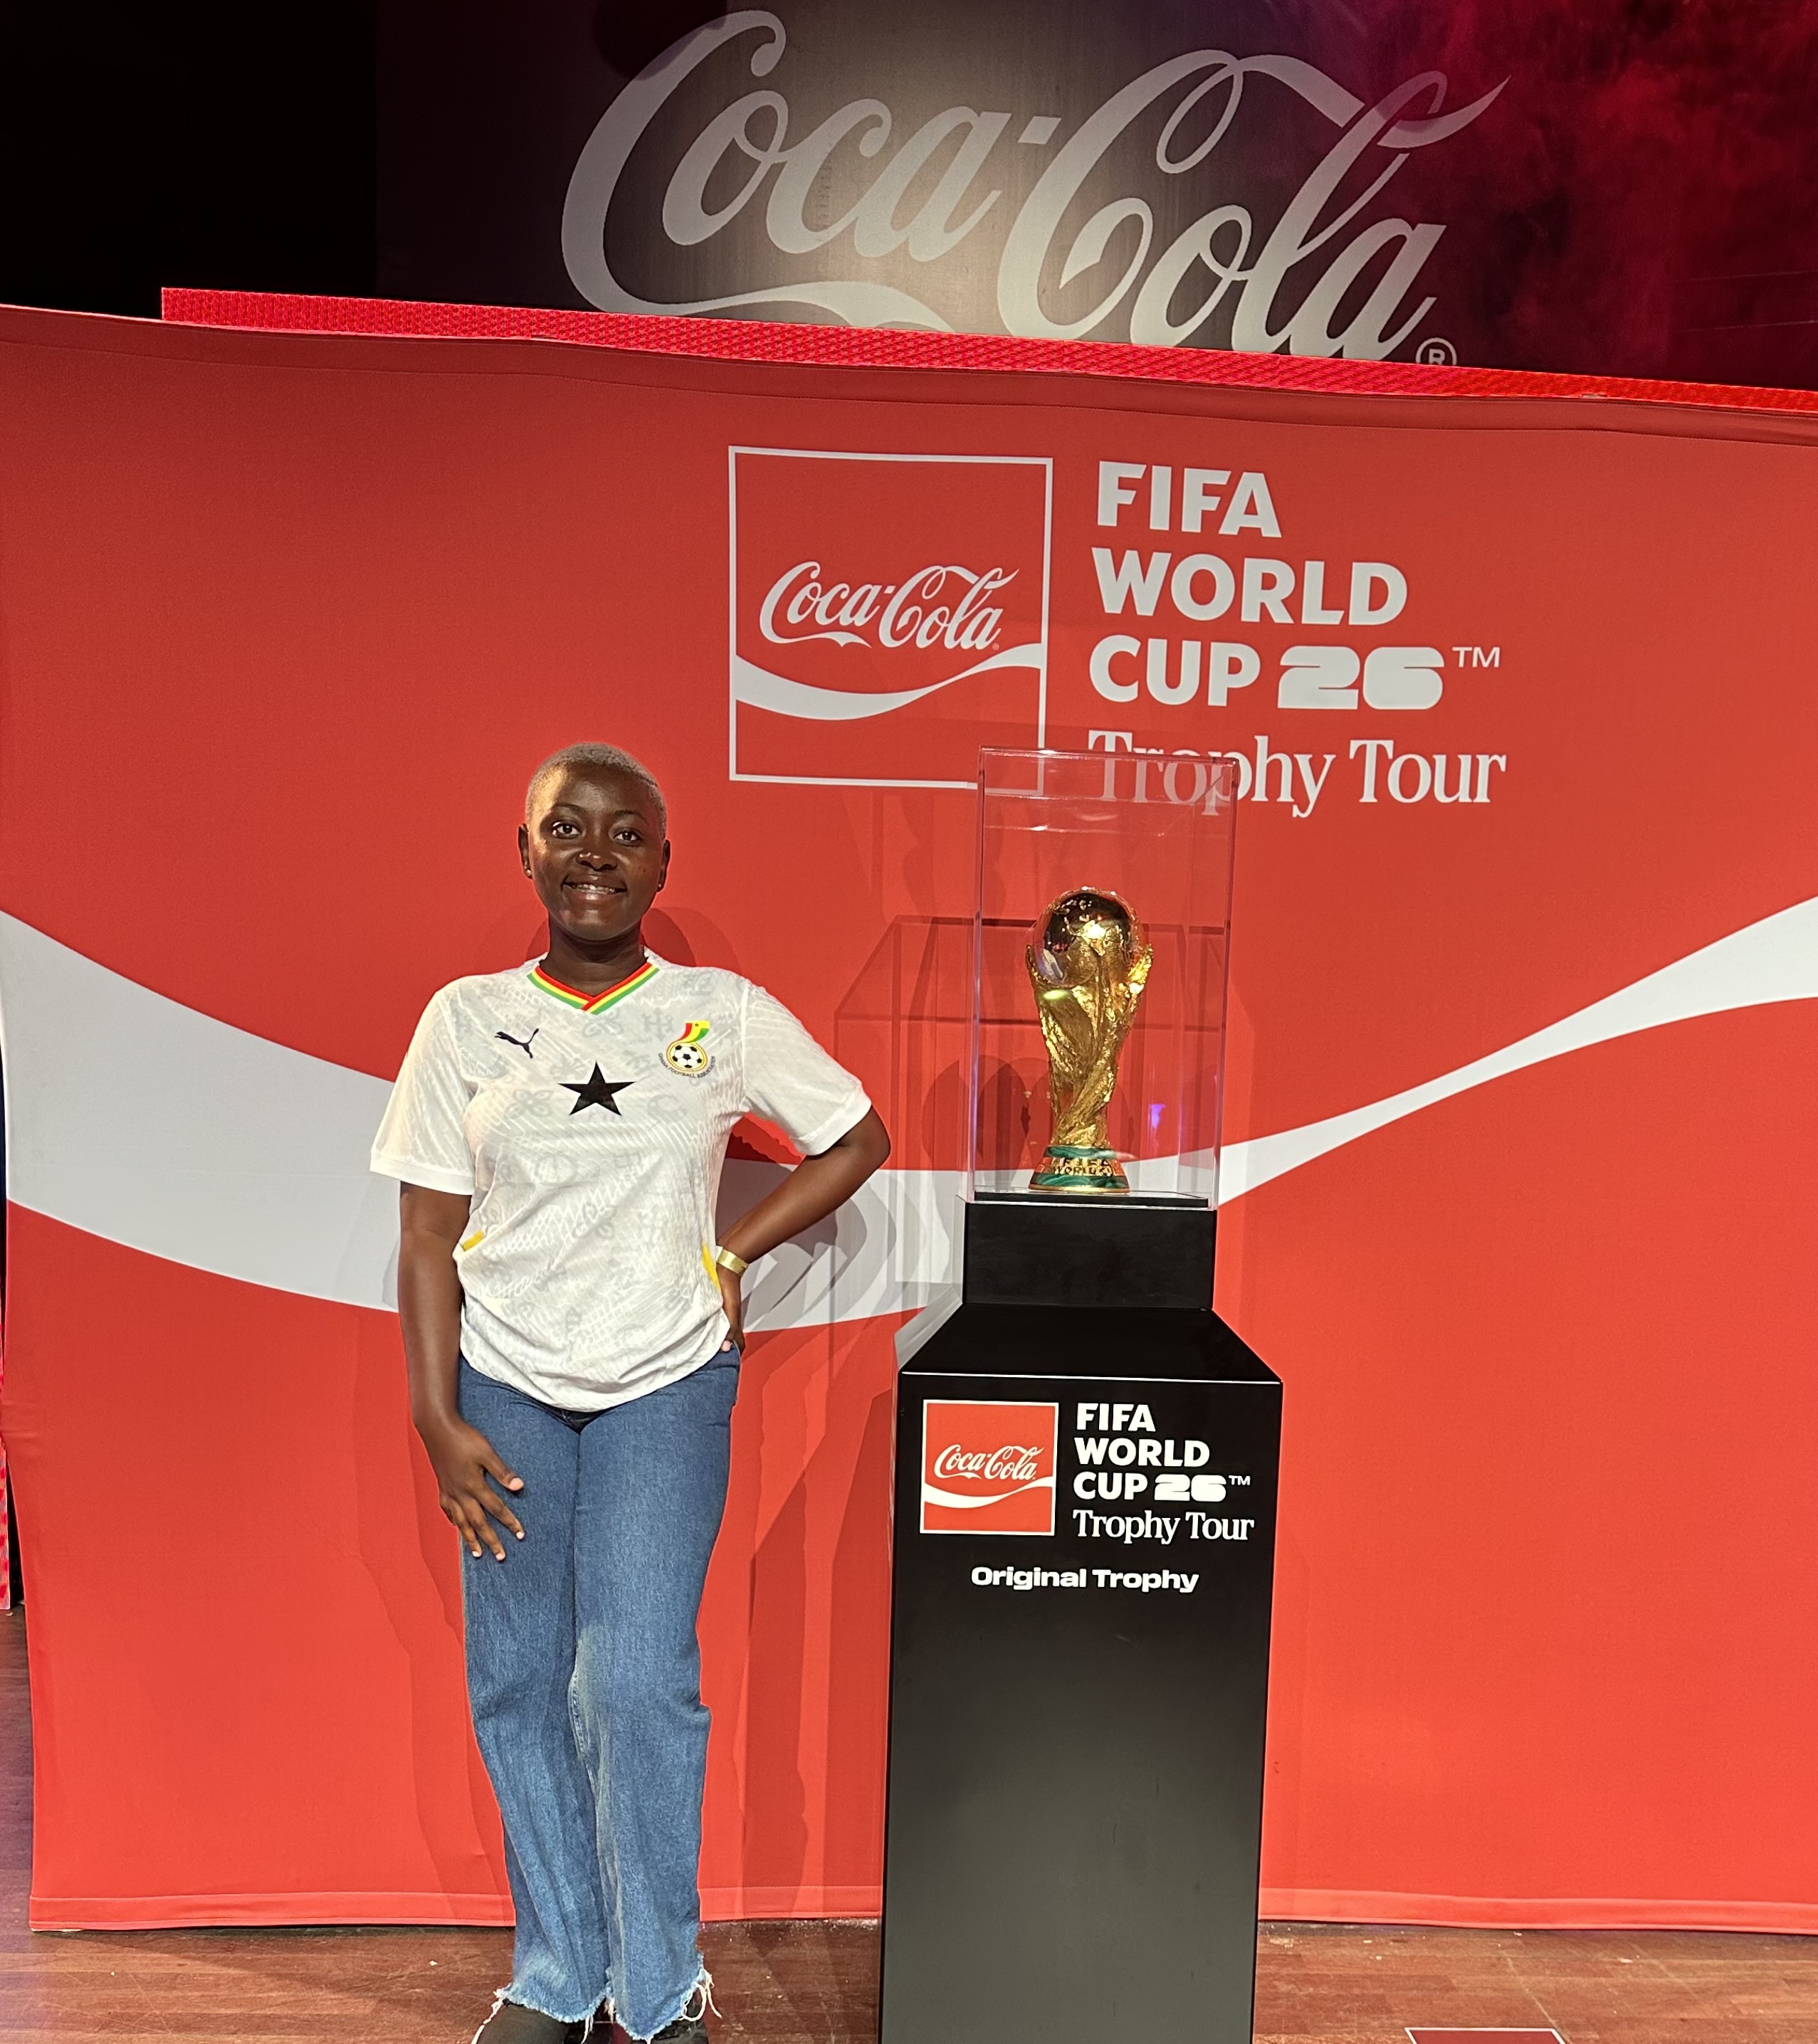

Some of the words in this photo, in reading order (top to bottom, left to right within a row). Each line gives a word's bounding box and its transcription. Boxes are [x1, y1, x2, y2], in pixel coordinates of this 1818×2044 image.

[562, 9, 1511, 361] Coca-Cola
[1097, 460, 1282, 538] FIFA
[759, 561, 1020, 650] Coca-Cola
[1091, 547, 1407, 626] WORLD
[1089, 634, 1261, 707] CUP
[1277, 646, 1445, 710] 26
[1088, 729, 1336, 818] Trophy
[1349, 739, 1507, 804] Tour
[1076, 1403, 1156, 1432] FIFA
[934, 1444, 1044, 1480] Coca-Cola
[1073, 1437, 1210, 1468] WORLD
[1073, 1471, 1148, 1500] CUP
[1154, 1474, 1227, 1502] 26
[1072, 1509, 1181, 1545] Trophy
[1185, 1512, 1255, 1541] Tour
[970, 1566, 1087, 1591] Original
[1092, 1569, 1199, 1593] Trophy
